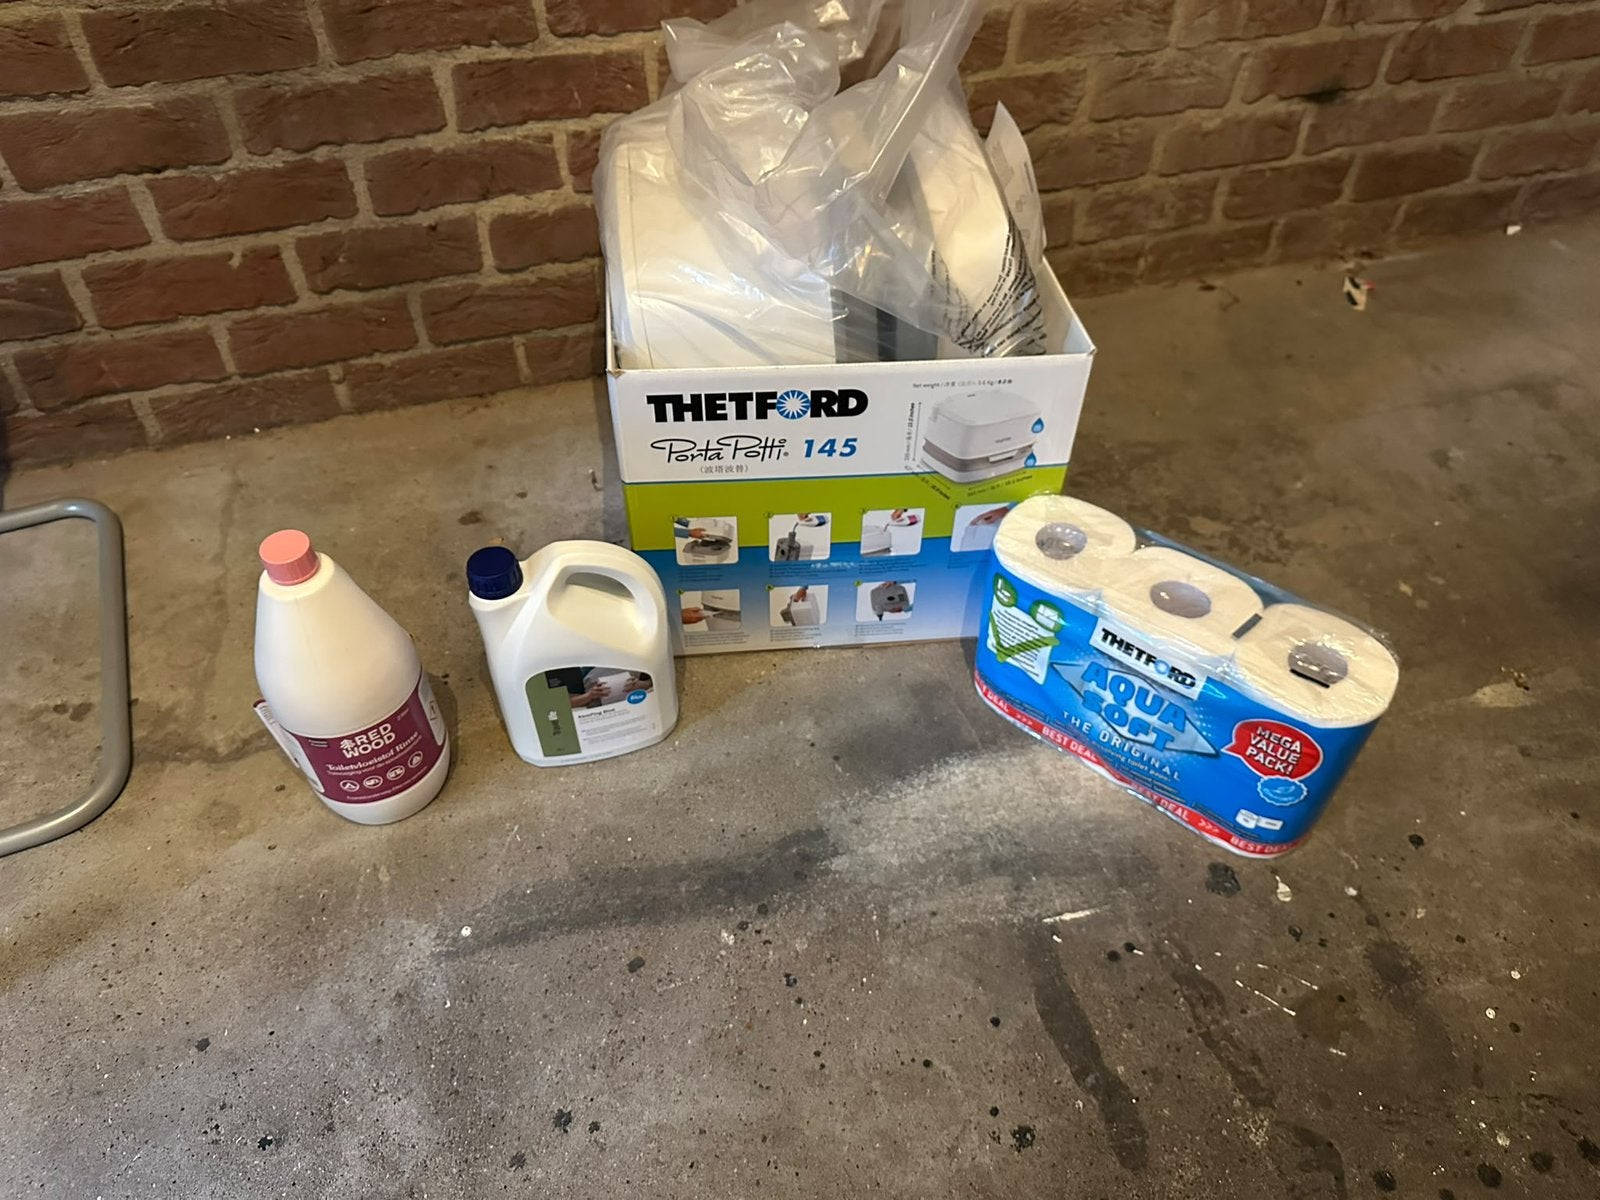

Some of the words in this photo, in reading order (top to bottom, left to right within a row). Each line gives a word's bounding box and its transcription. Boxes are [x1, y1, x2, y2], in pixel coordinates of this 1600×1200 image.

[646, 389, 869, 423] THETFORD
[650, 438, 724, 463] Porta
[716, 435, 787, 462] Potti
[804, 438, 858, 458] 145
[1101, 628, 1197, 690] THETFORD
[1081, 660, 1188, 733] AQUA
[354, 723, 392, 746] RED
[1081, 690, 1175, 752] SOFT
[342, 732, 396, 759] WOOD
[395, 731, 418, 752] Rinse
[1063, 711, 1092, 734] THE
[1099, 729, 1181, 781] ORIGINAL
[1250, 733, 1301, 764] VALUE
[1256, 726, 1301, 753] MEGA
[987, 690, 1009, 713] DEAL
[1042, 725, 1068, 748] BEST
[1069, 742, 1100, 764] DEAL
[1160, 799, 1190, 821] DEAL
[1230, 836, 1262, 853] BEST
[1245, 746, 1294, 775] PACK!
